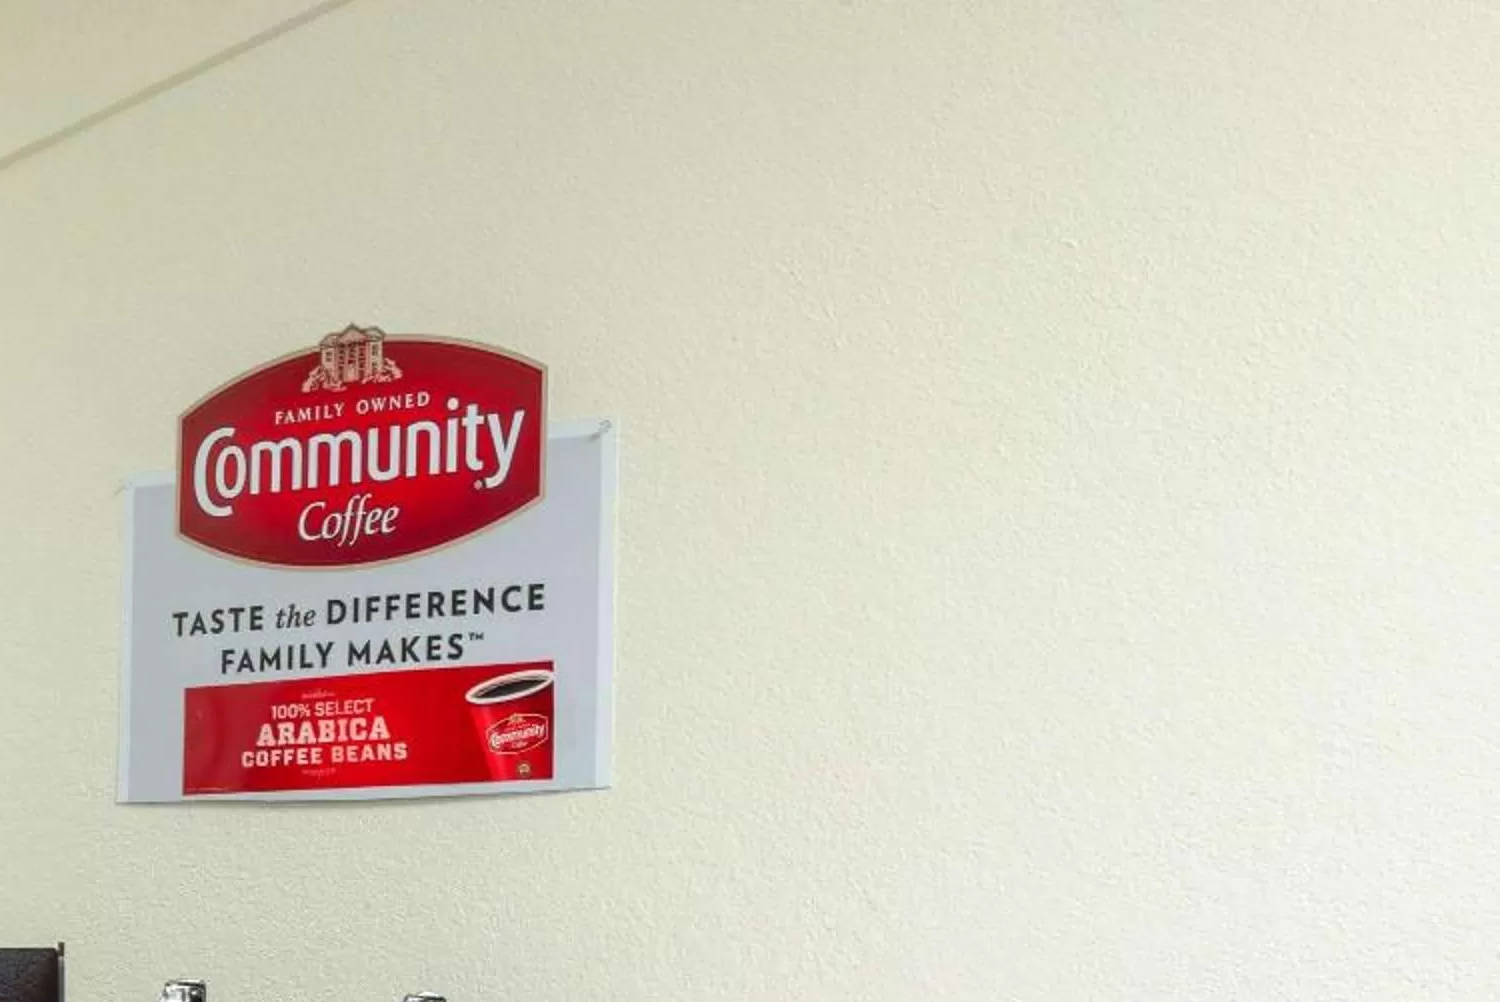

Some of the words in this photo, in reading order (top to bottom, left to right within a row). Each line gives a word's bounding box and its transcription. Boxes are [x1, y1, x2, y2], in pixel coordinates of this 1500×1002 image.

[275, 402, 344, 425] FAMILY
[356, 392, 430, 415] OWNED
[193, 397, 526, 517] Community
[298, 493, 400, 547] Coffee
[172, 606, 264, 638] TASTE
[275, 603, 316, 630] the
[327, 583, 546, 626] DIFFERENCE
[221, 642, 334, 675] FAMILY
[271, 704, 311, 720] 100%
[314, 698, 375, 717] SELECT
[256, 716, 391, 746] ARABICA
[241, 748, 323, 768] COFFEE
[331, 743, 408, 763] BEANS
